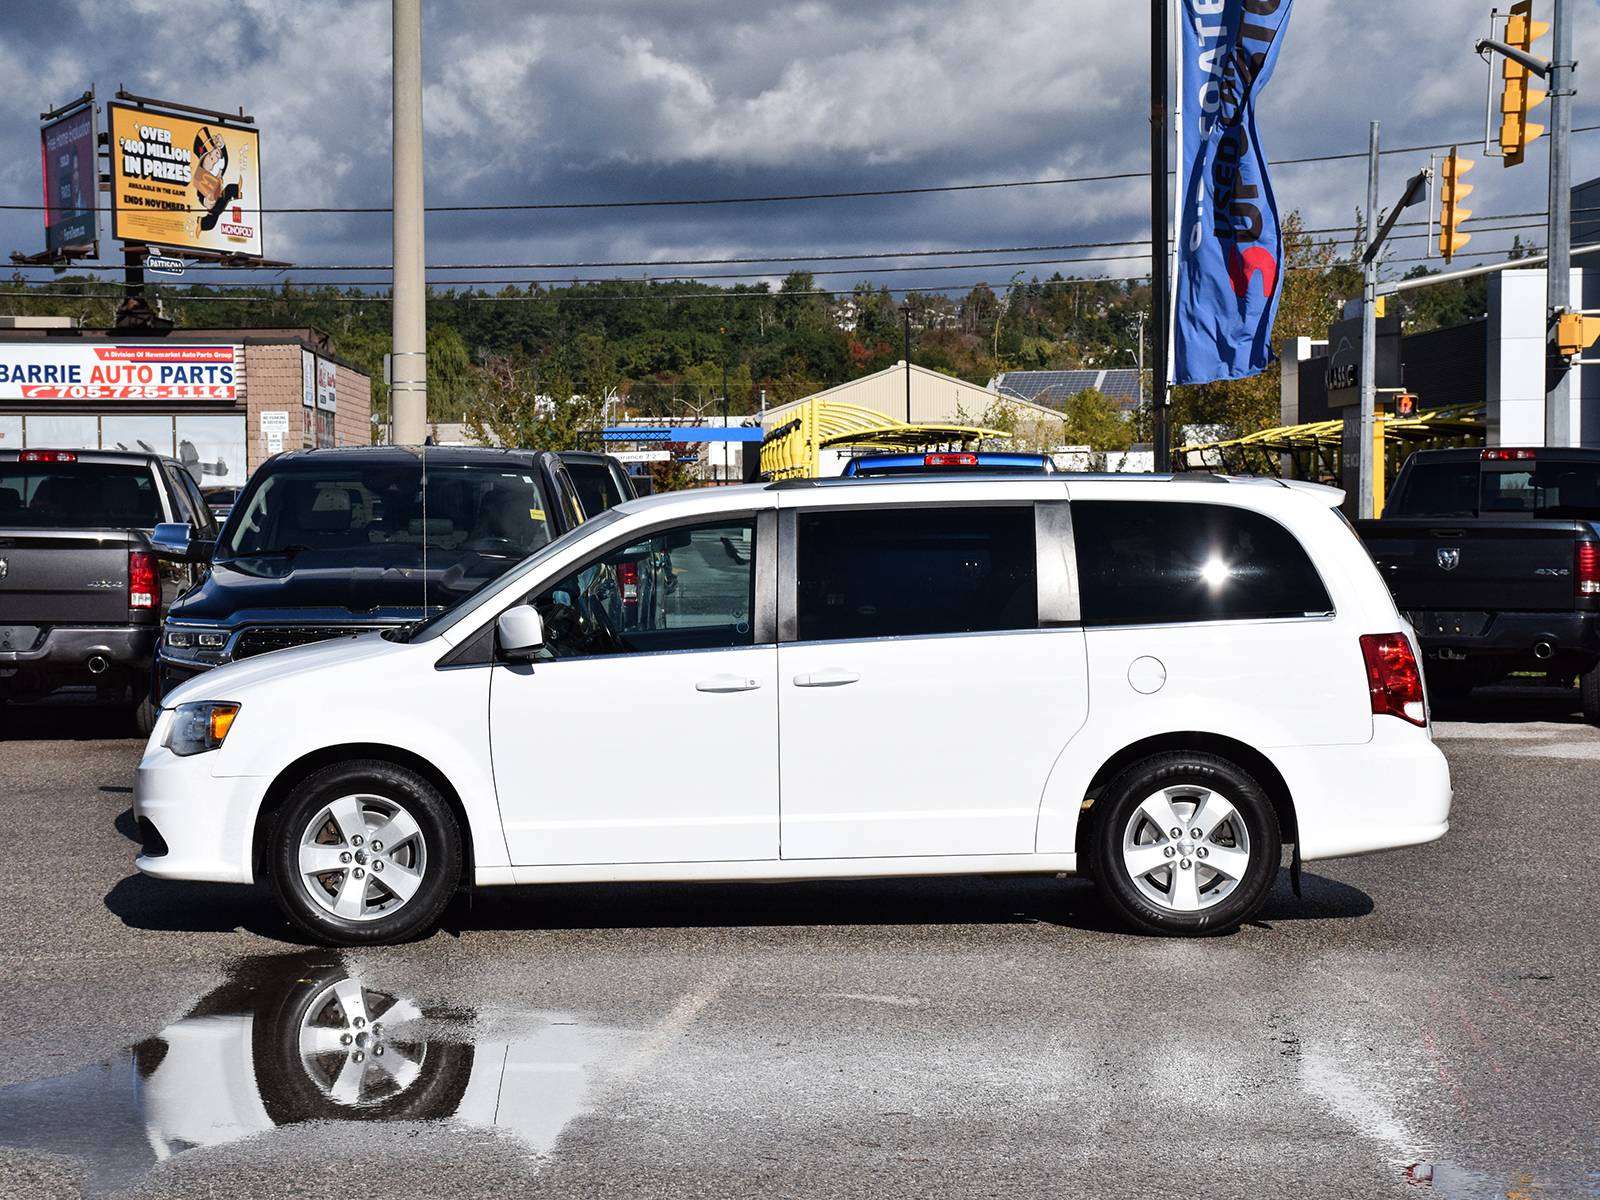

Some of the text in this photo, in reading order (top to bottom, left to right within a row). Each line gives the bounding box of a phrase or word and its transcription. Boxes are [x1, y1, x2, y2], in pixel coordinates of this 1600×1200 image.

[140, 125, 172, 144] OVER
[146, 142, 192, 163] MILLION
[124, 155, 192, 183] IN PRIZES
[123, 194, 144, 206] ENDS
[144, 198, 185, 211] NOVEMBER
[221, 224, 253, 238] MONOPOLY
[214, 351, 232, 359] Group
[0, 364, 234, 385] BARRIE AUTO PARTS
[56, 385, 229, 398] 705-725-1114
